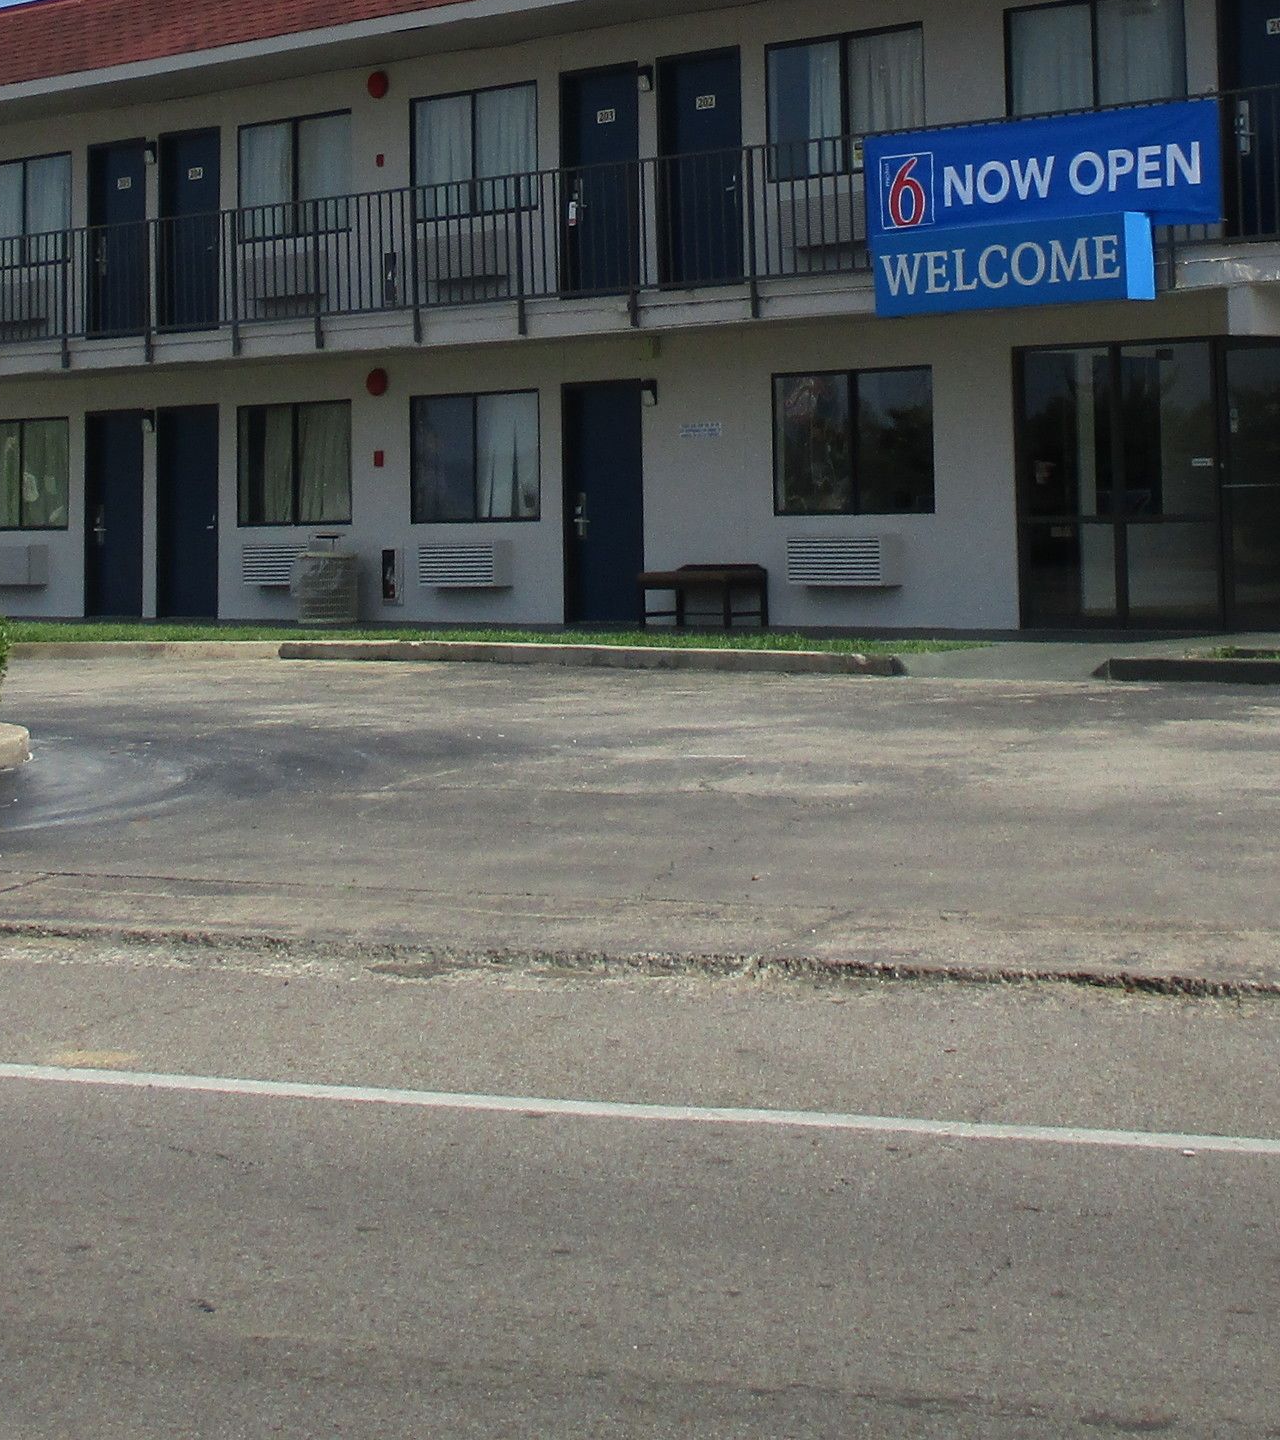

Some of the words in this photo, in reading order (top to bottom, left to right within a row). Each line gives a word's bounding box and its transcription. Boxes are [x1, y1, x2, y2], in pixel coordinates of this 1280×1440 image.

[697, 96, 714, 108] 202
[888, 156, 926, 228] 6
[943, 155, 1056, 208] NOW
[1069, 141, 1202, 196] OPEN
[879, 234, 1121, 297] WELCOME
